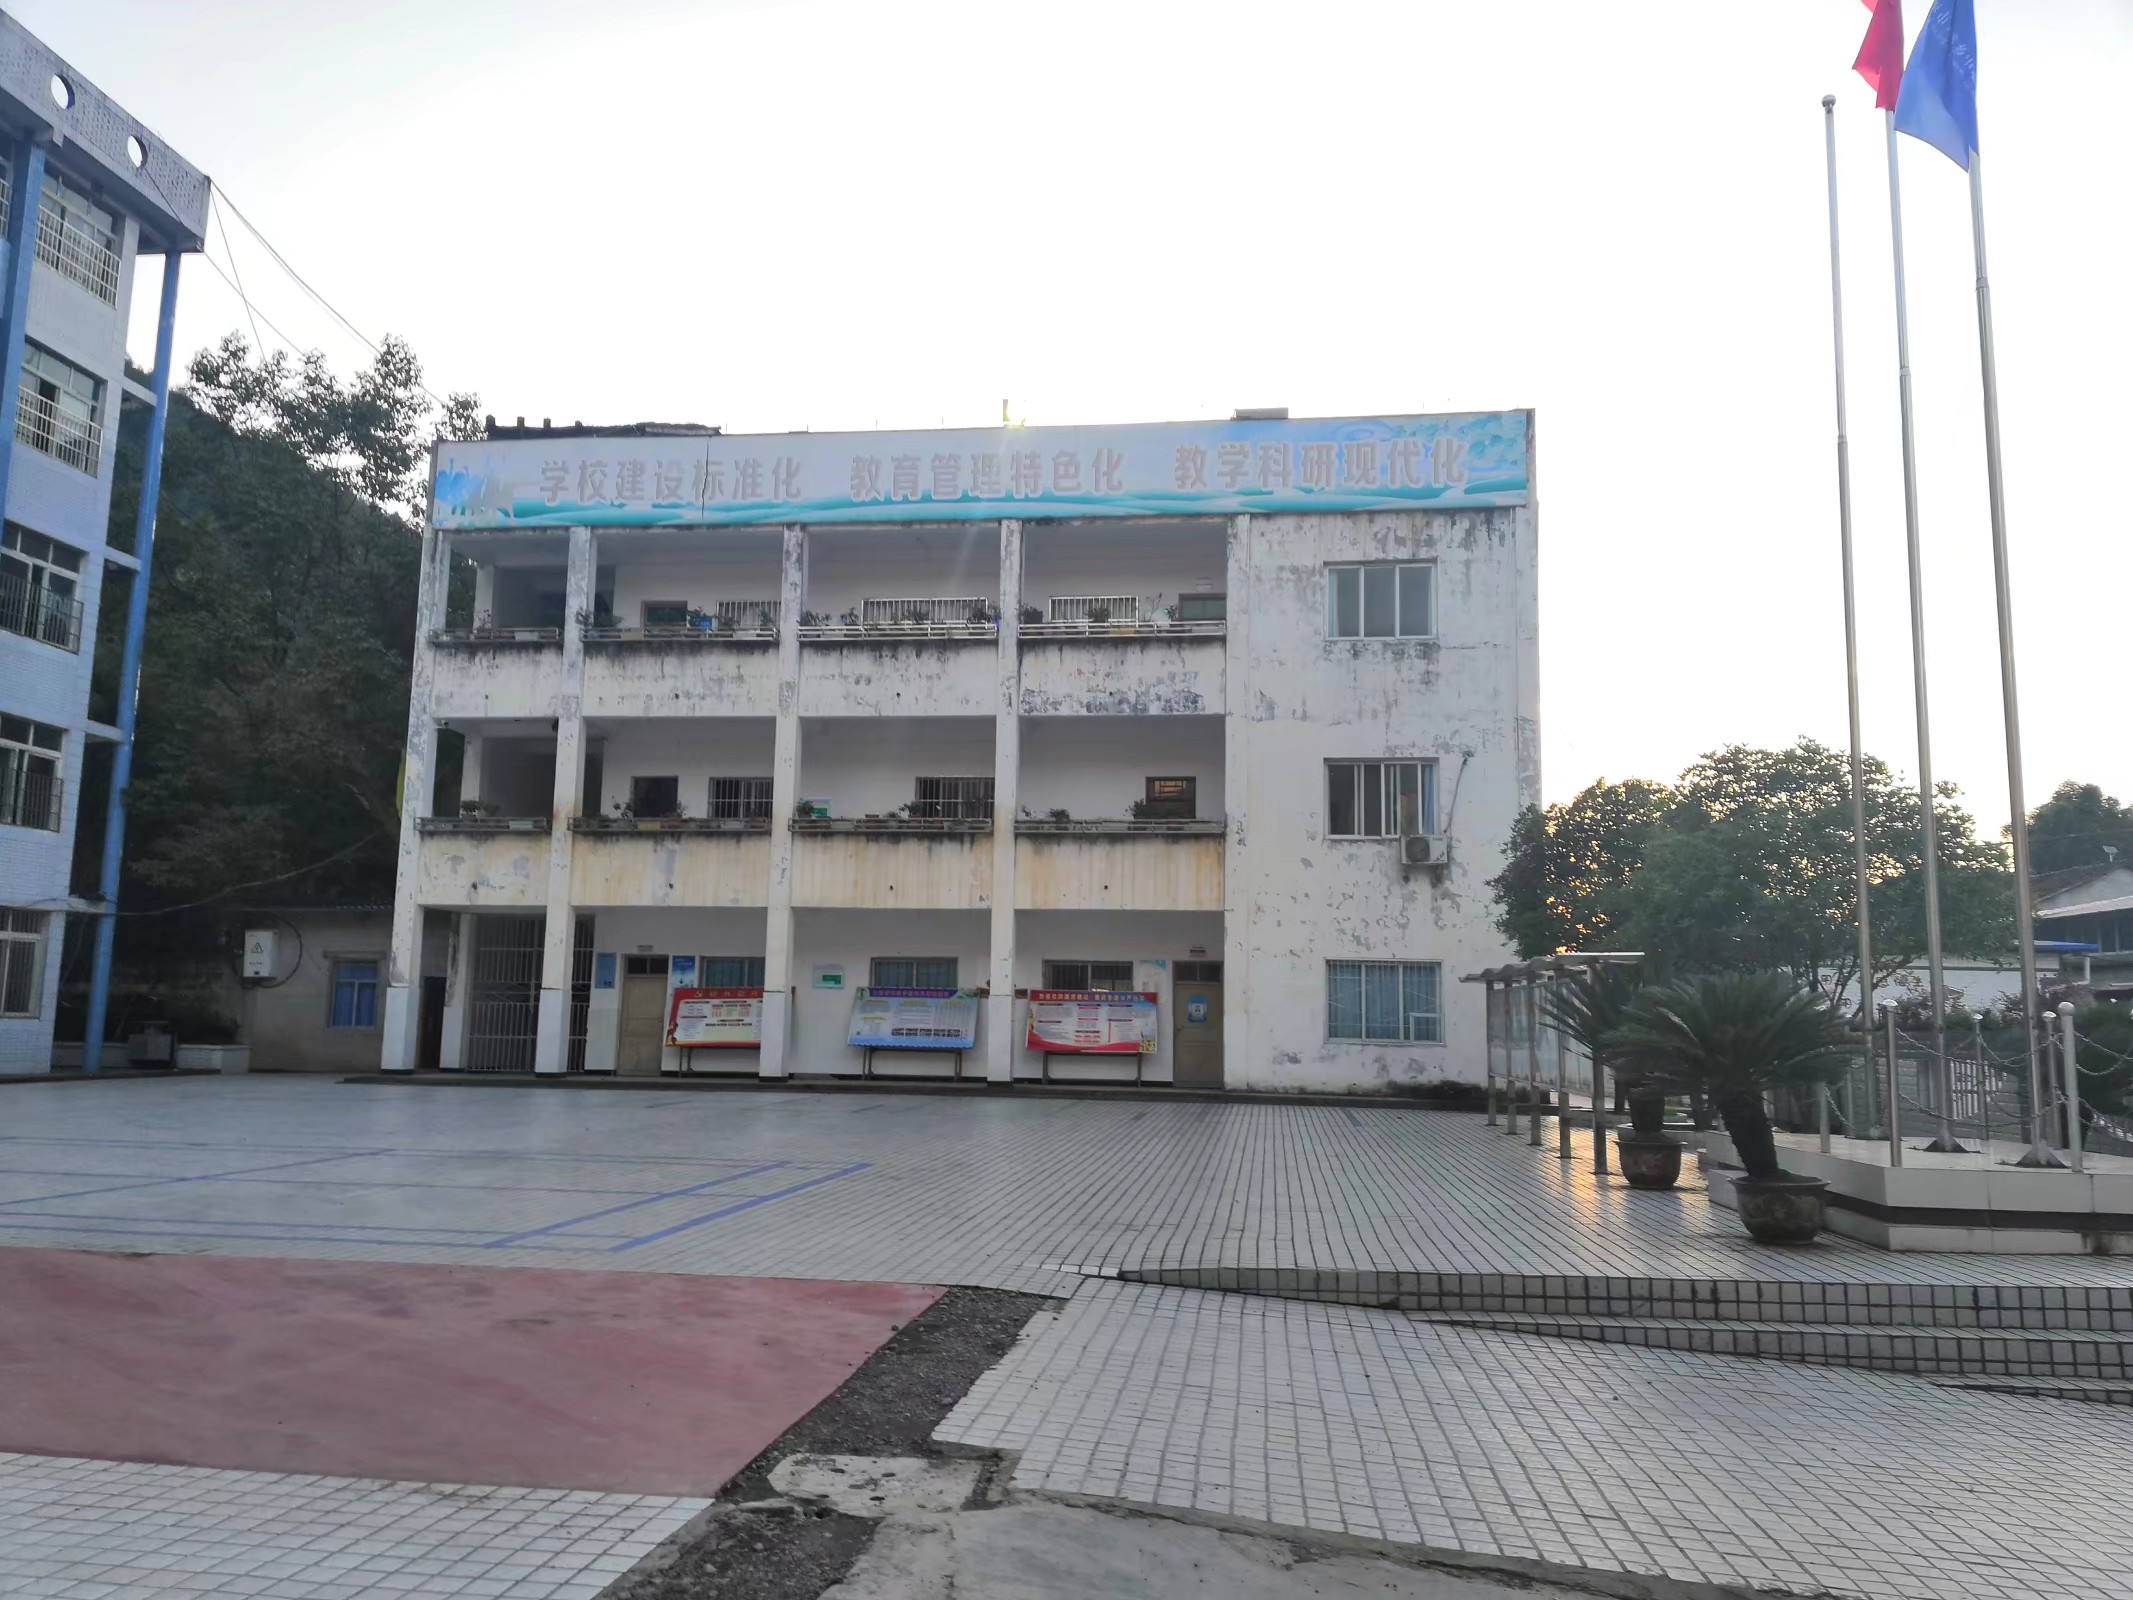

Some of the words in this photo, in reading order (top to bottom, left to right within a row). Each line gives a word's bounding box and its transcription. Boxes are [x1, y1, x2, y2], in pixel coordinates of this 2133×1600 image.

[540, 456, 801, 503] 学校建设标准化
[851, 450, 1125, 500] 教育管理特色化
[1175, 438, 1466, 489] 教学科研现代化
